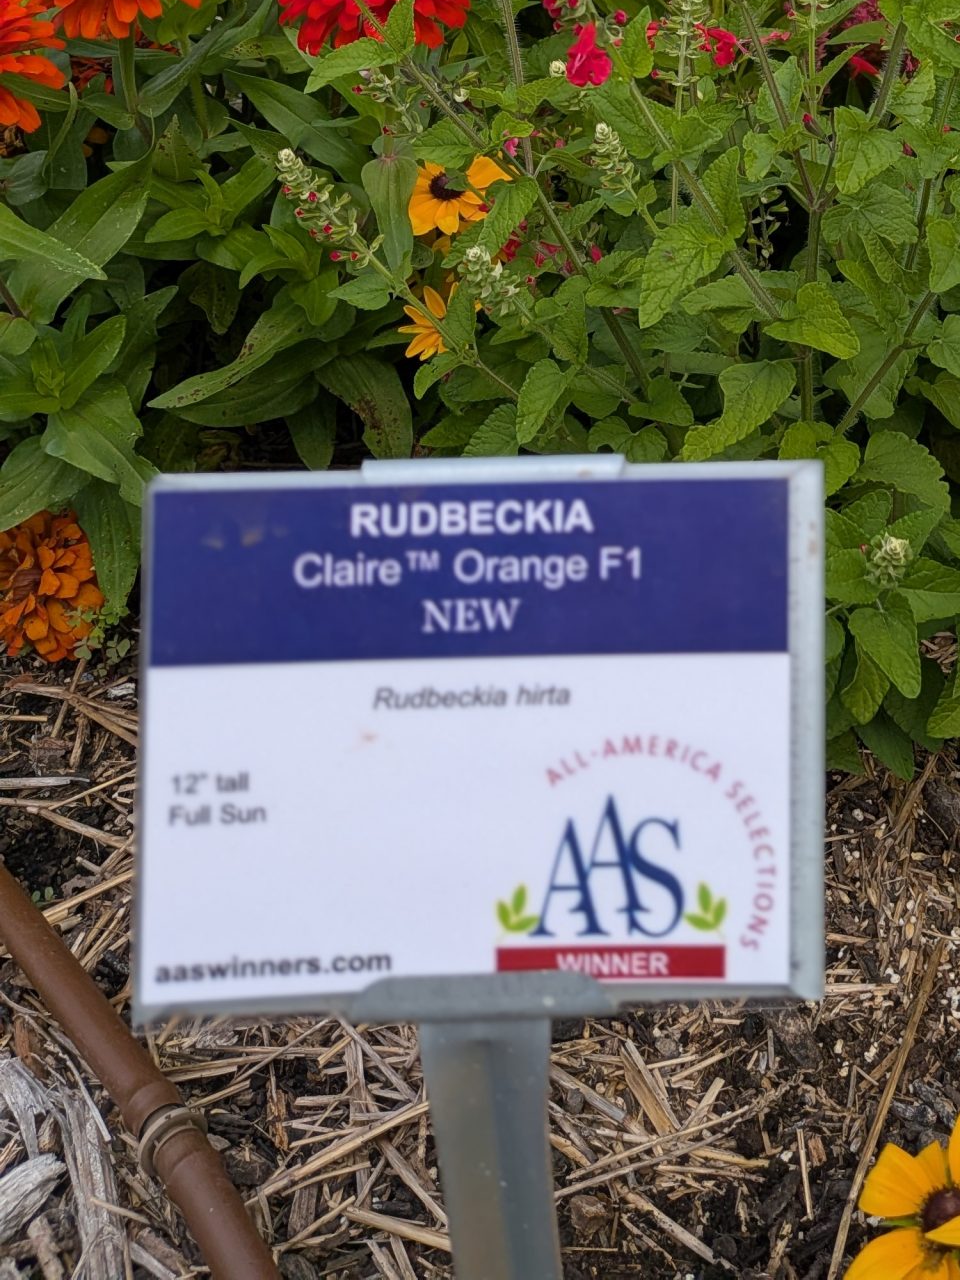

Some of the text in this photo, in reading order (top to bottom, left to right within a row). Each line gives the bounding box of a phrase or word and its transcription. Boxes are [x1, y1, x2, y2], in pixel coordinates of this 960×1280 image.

[349, 501, 594, 537] RUDBECKIA
[453, 549, 588, 588] Orange
[599, 547, 643, 579] F1
[421, 599, 520, 632] NEW
[373, 685, 571, 711] Rudbeckia hirta
[215, 772, 249, 793] tall
[169, 803, 266, 826] Full Sun
[545, 735, 776, 951] ALL-AMERICA SELECTIONS
[529, 794, 684, 938] AAS
[155, 951, 391, 983] aaswinners.com
[556, 952, 668, 975] WINNER
